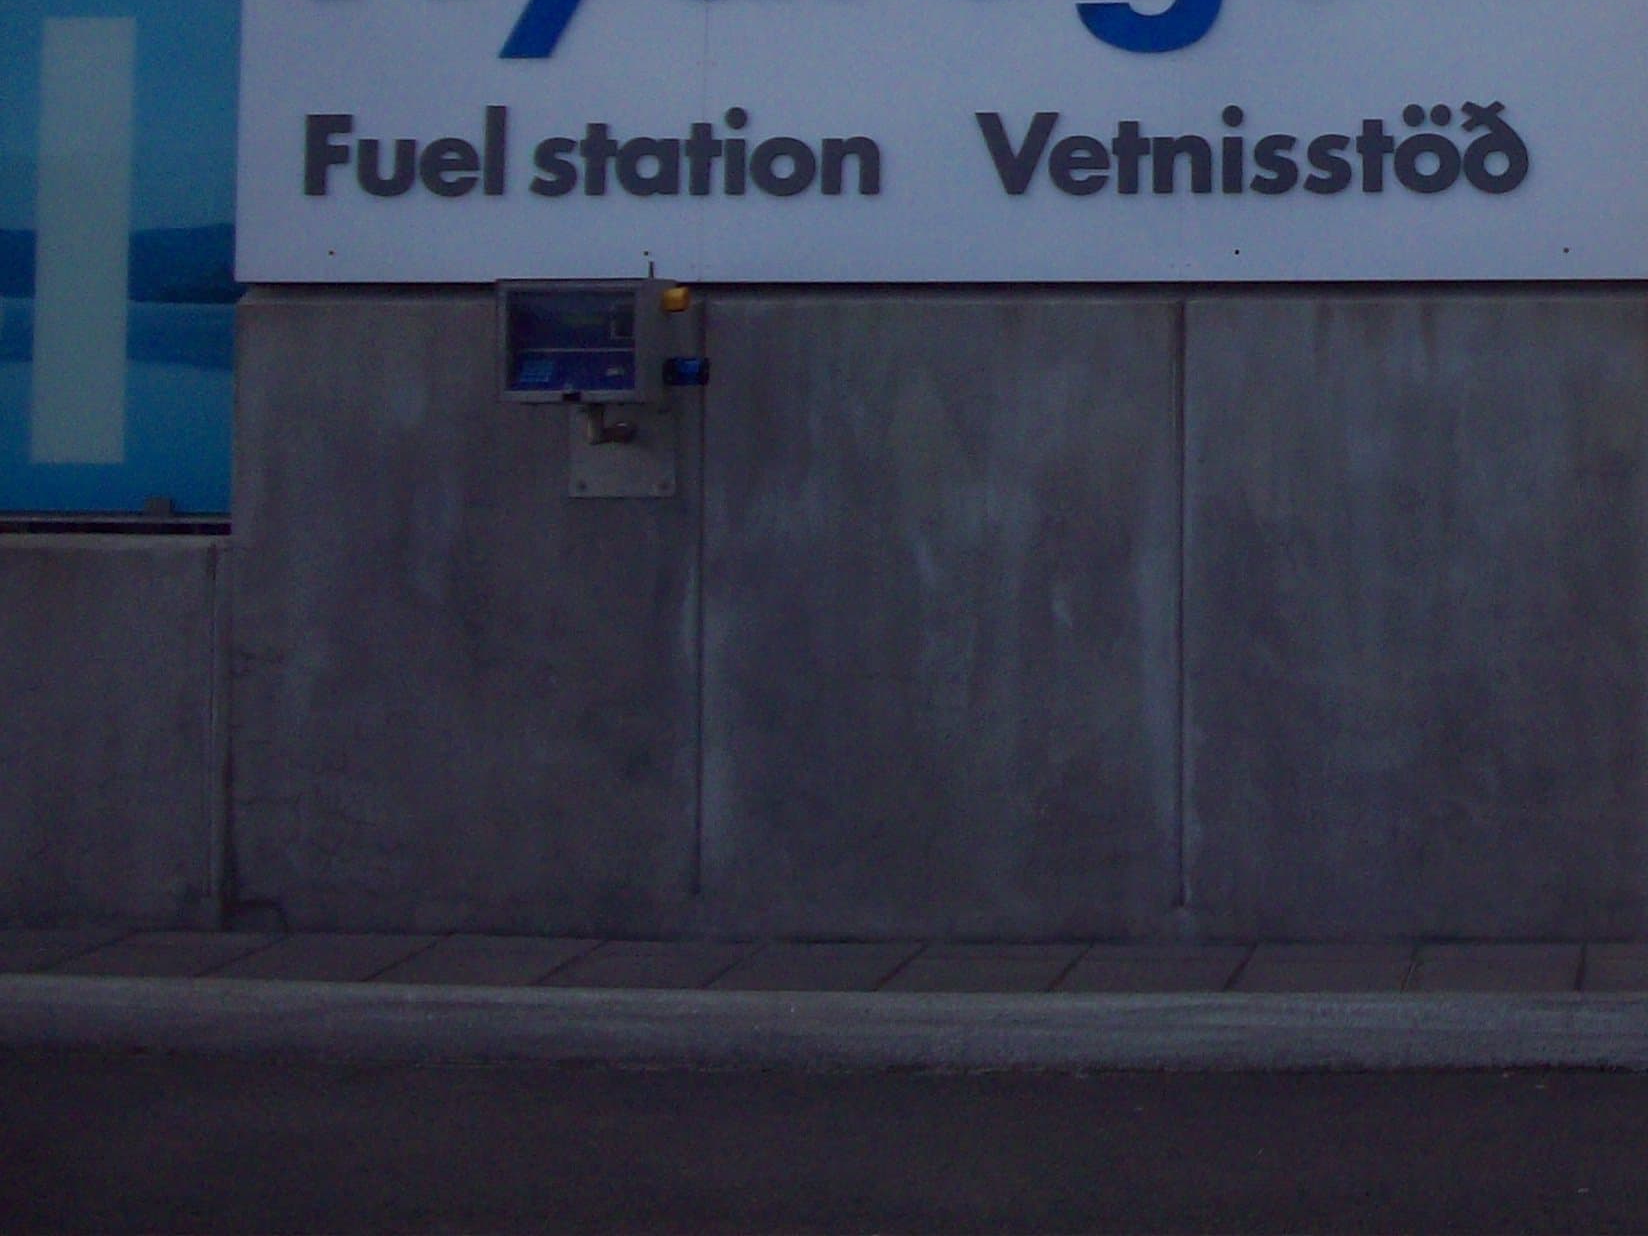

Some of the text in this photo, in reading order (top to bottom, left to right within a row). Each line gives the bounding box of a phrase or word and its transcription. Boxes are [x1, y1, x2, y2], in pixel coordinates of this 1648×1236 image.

[303, 105, 882, 198] Fuel station
[975, 100, 1530, 196] Vetnisstöð
